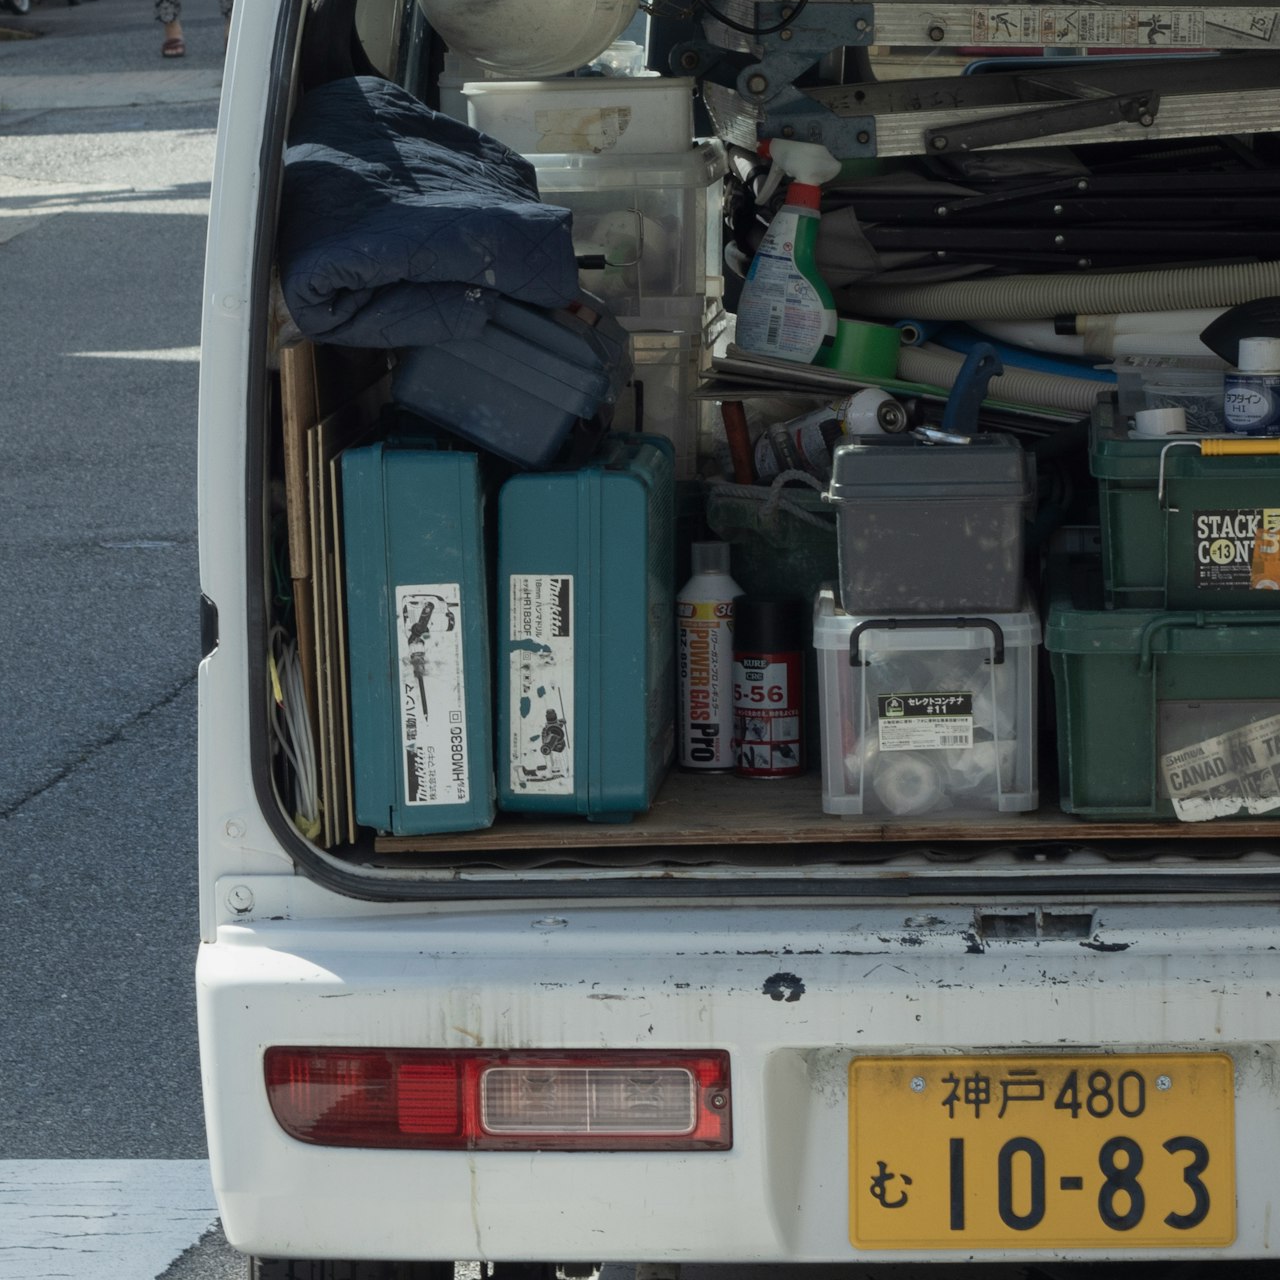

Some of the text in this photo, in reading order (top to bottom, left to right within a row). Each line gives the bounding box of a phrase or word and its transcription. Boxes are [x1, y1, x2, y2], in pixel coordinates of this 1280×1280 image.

[1197, 514, 1262, 539] STACK
[689, 628, 711, 687] POWER
[743, 659, 768, 668] KURE
[404, 683, 418, 742] 電動ハンマ
[689, 688, 711, 721] GAS
[907, 696, 964, 707] セレクトコンテナ
[926, 705, 947, 714] #11
[690, 722, 720, 763] Pro
[869, 1135, 1212, 1232] む 10-83
